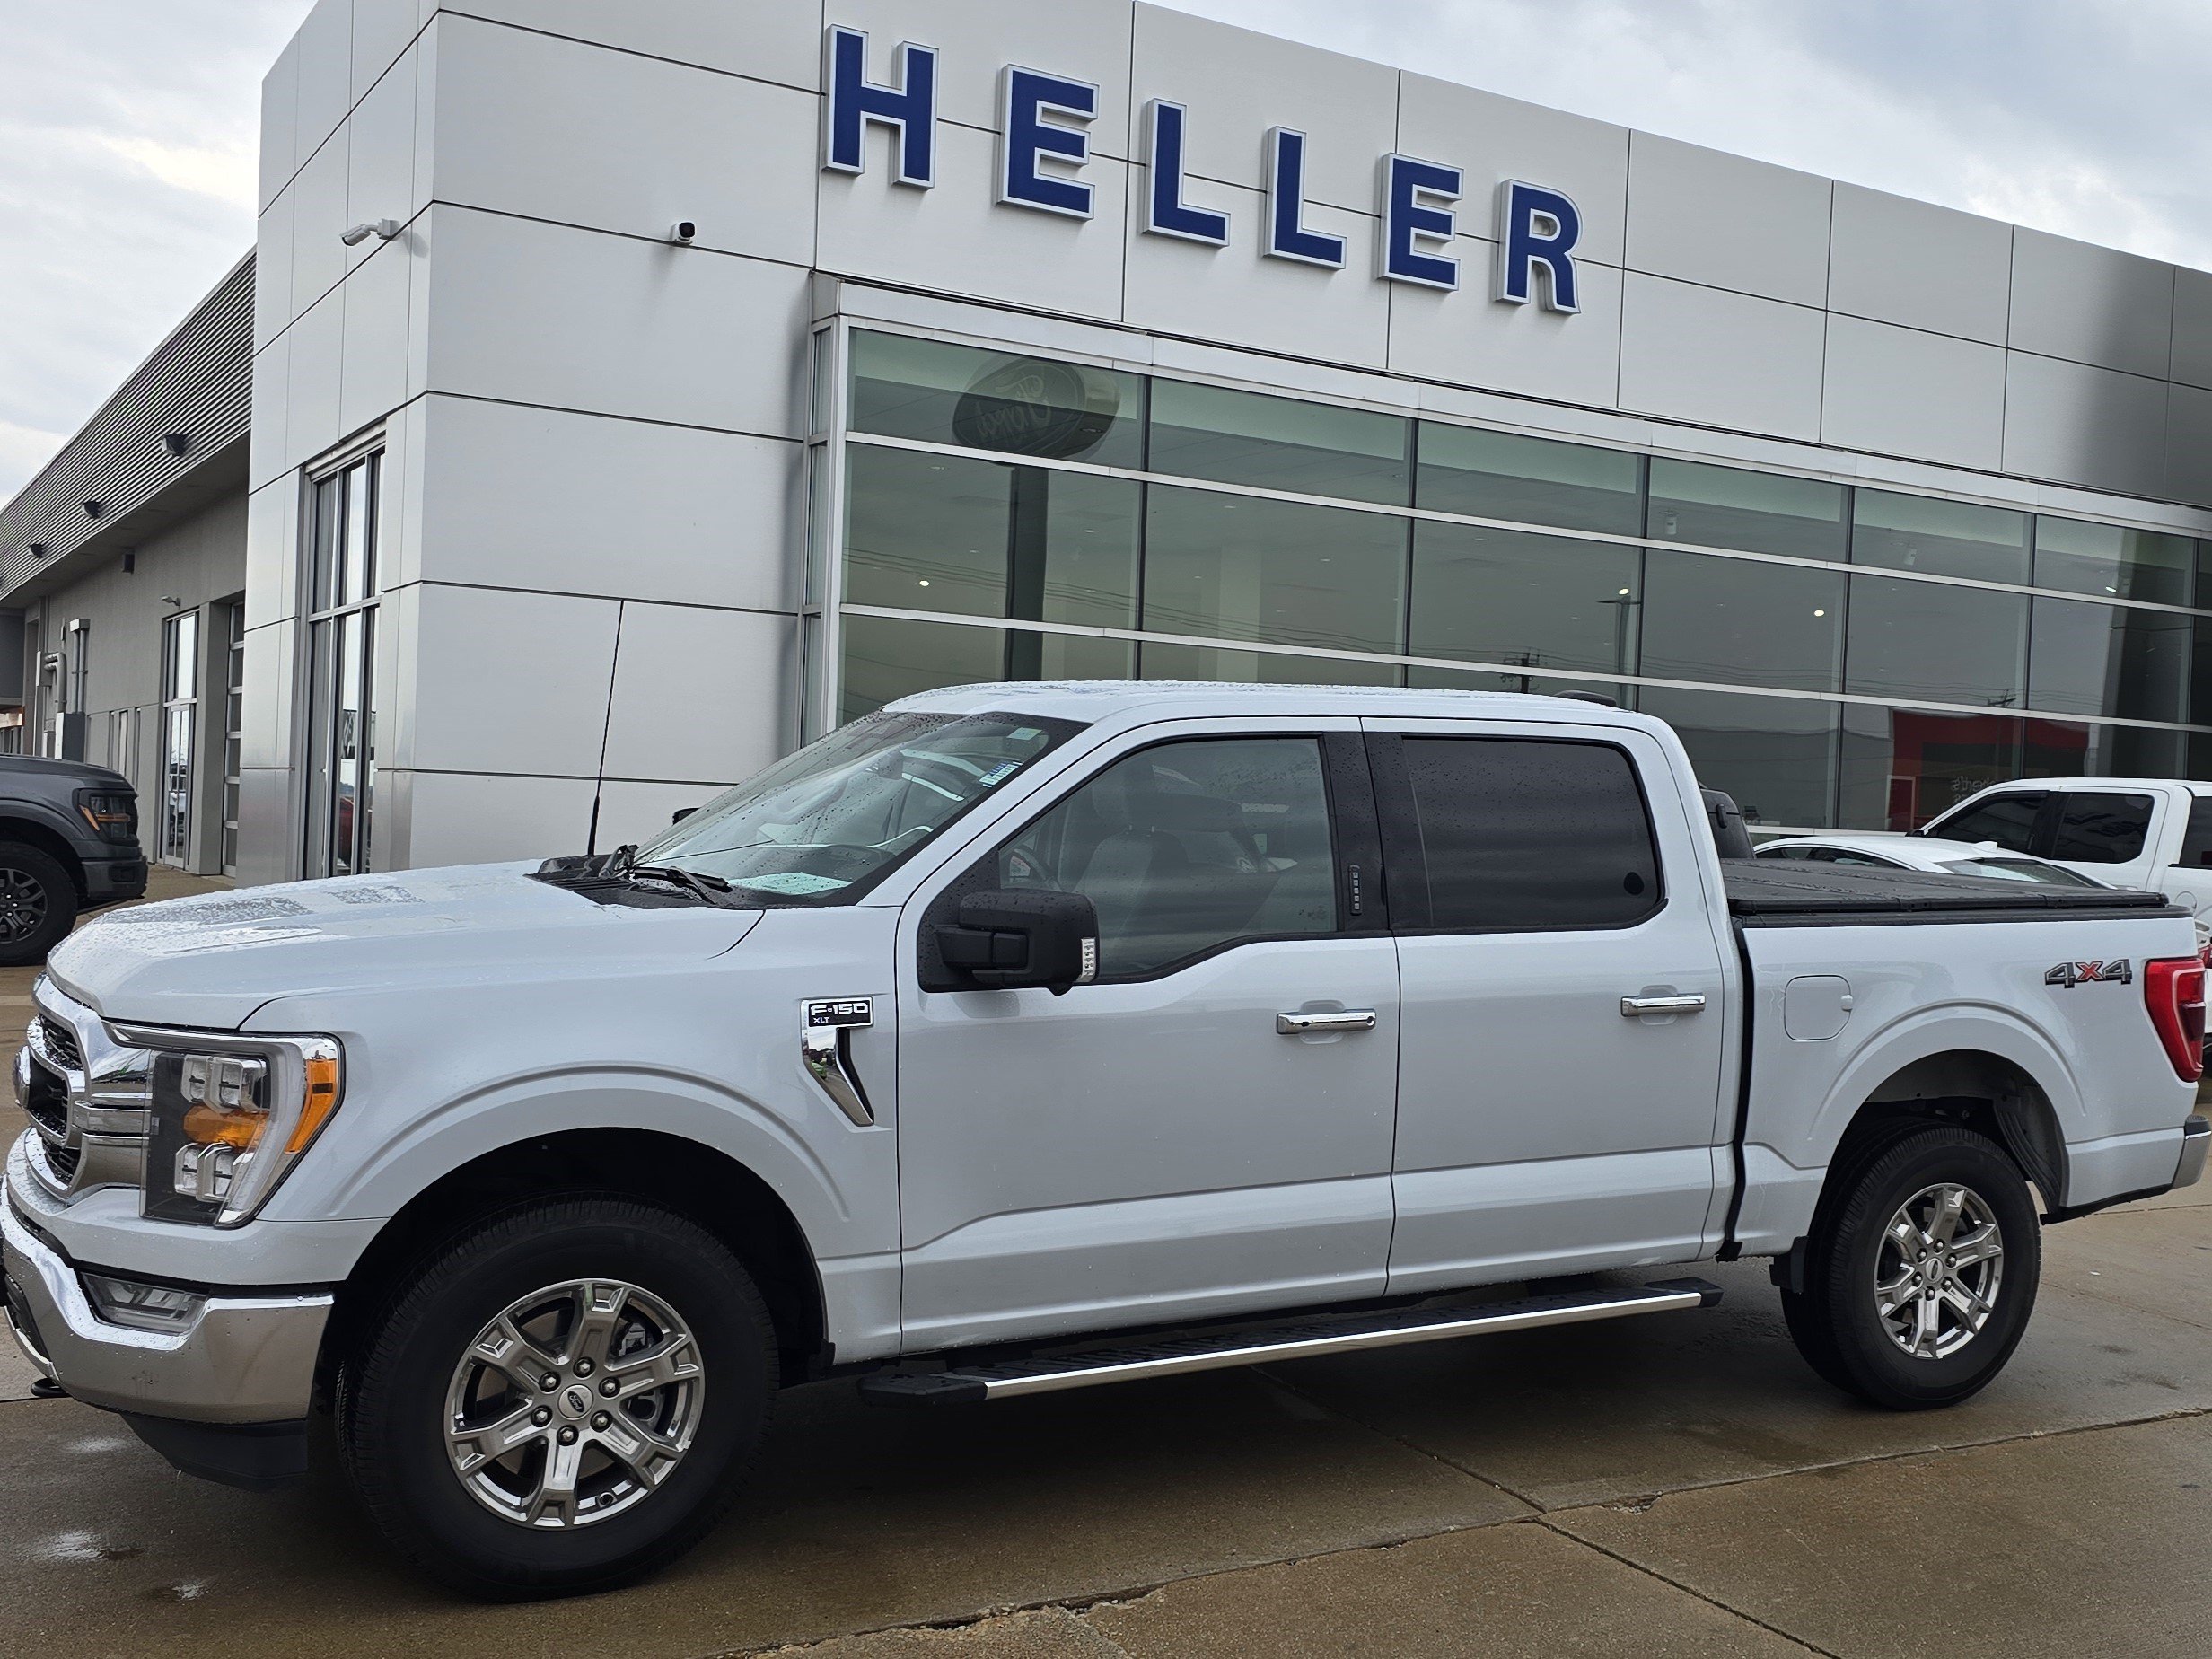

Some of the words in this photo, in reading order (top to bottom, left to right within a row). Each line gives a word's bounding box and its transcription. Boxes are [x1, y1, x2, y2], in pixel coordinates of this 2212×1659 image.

[822, 23, 1583, 315] HELLER
[810, 1002, 869, 1015] F-150
[568, 1393, 583, 1410] Ford
